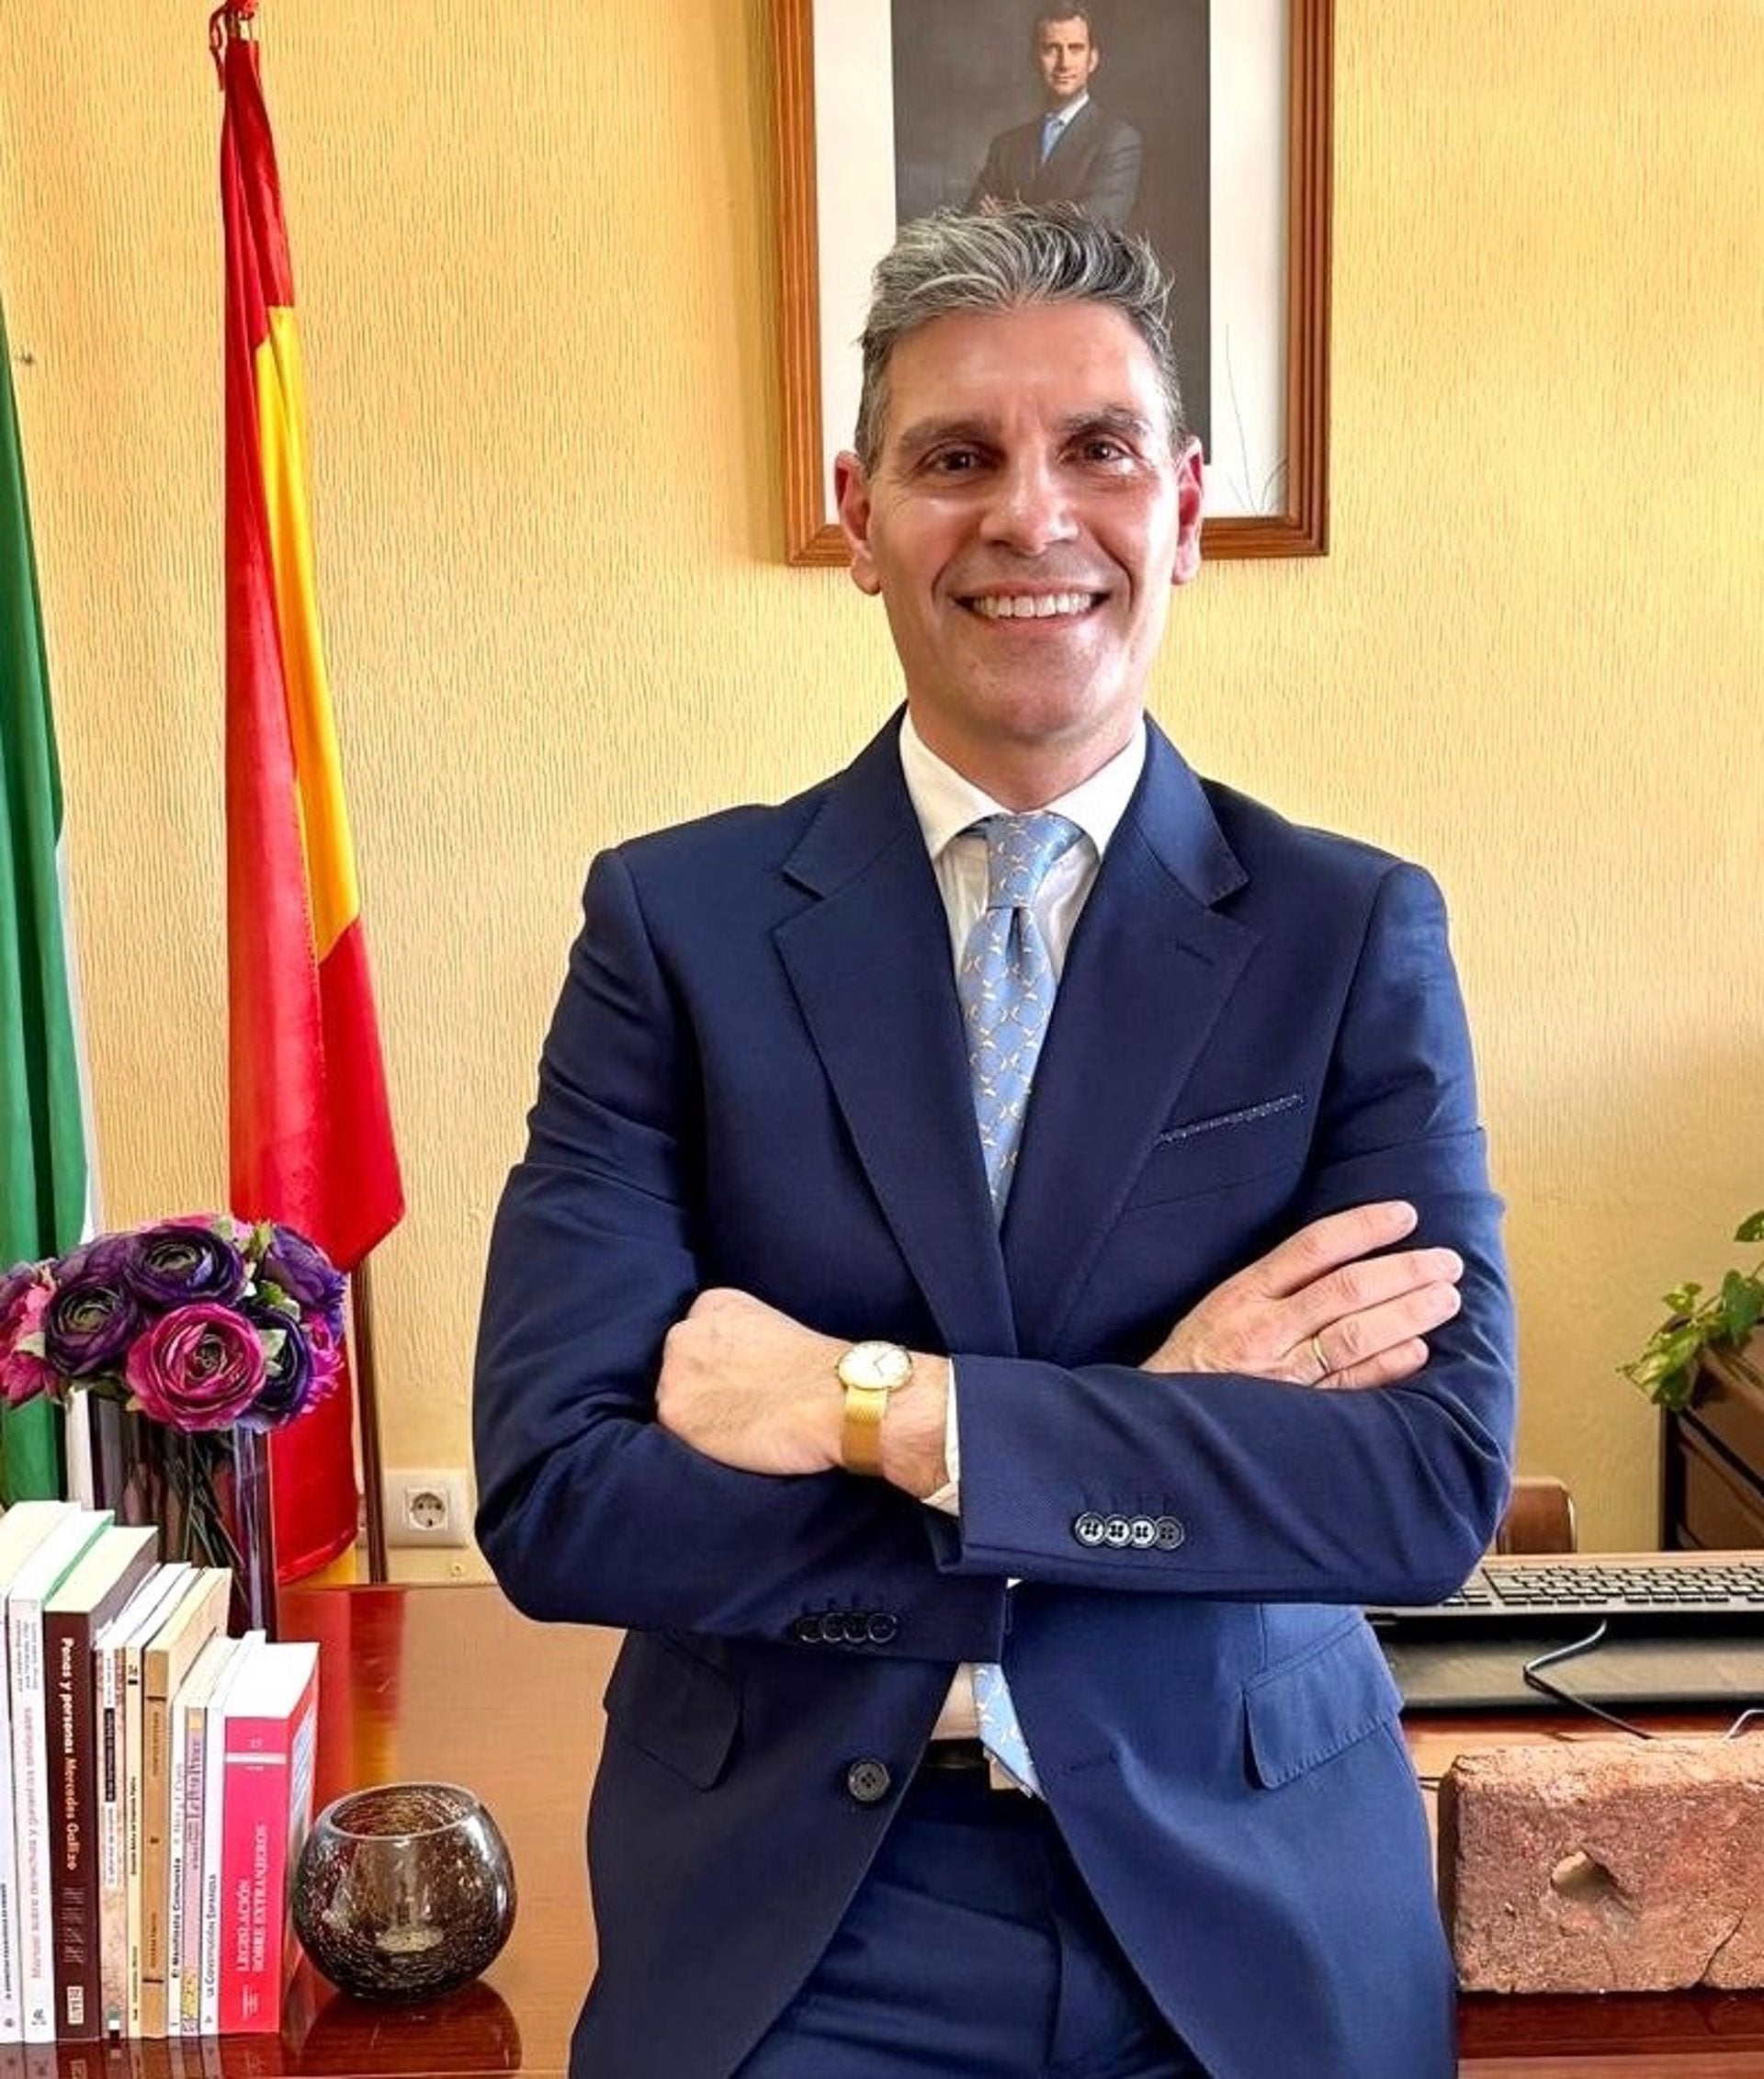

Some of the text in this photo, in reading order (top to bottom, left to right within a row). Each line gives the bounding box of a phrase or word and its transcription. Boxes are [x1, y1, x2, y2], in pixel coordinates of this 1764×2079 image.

[60, 1681, 74, 1689] y
[61, 1636, 74, 1678] Penas
[59, 1693, 74, 1754] personas
[63, 1757, 79, 1819] Mercedes
[66, 1822, 80, 1870] Gallizo
[172, 1858, 182, 1912] Comunista
[251, 1825, 267, 1972] SOBRE EXTRANJEROS
[236, 1880, 250, 1972] LEGISLACIÓN
